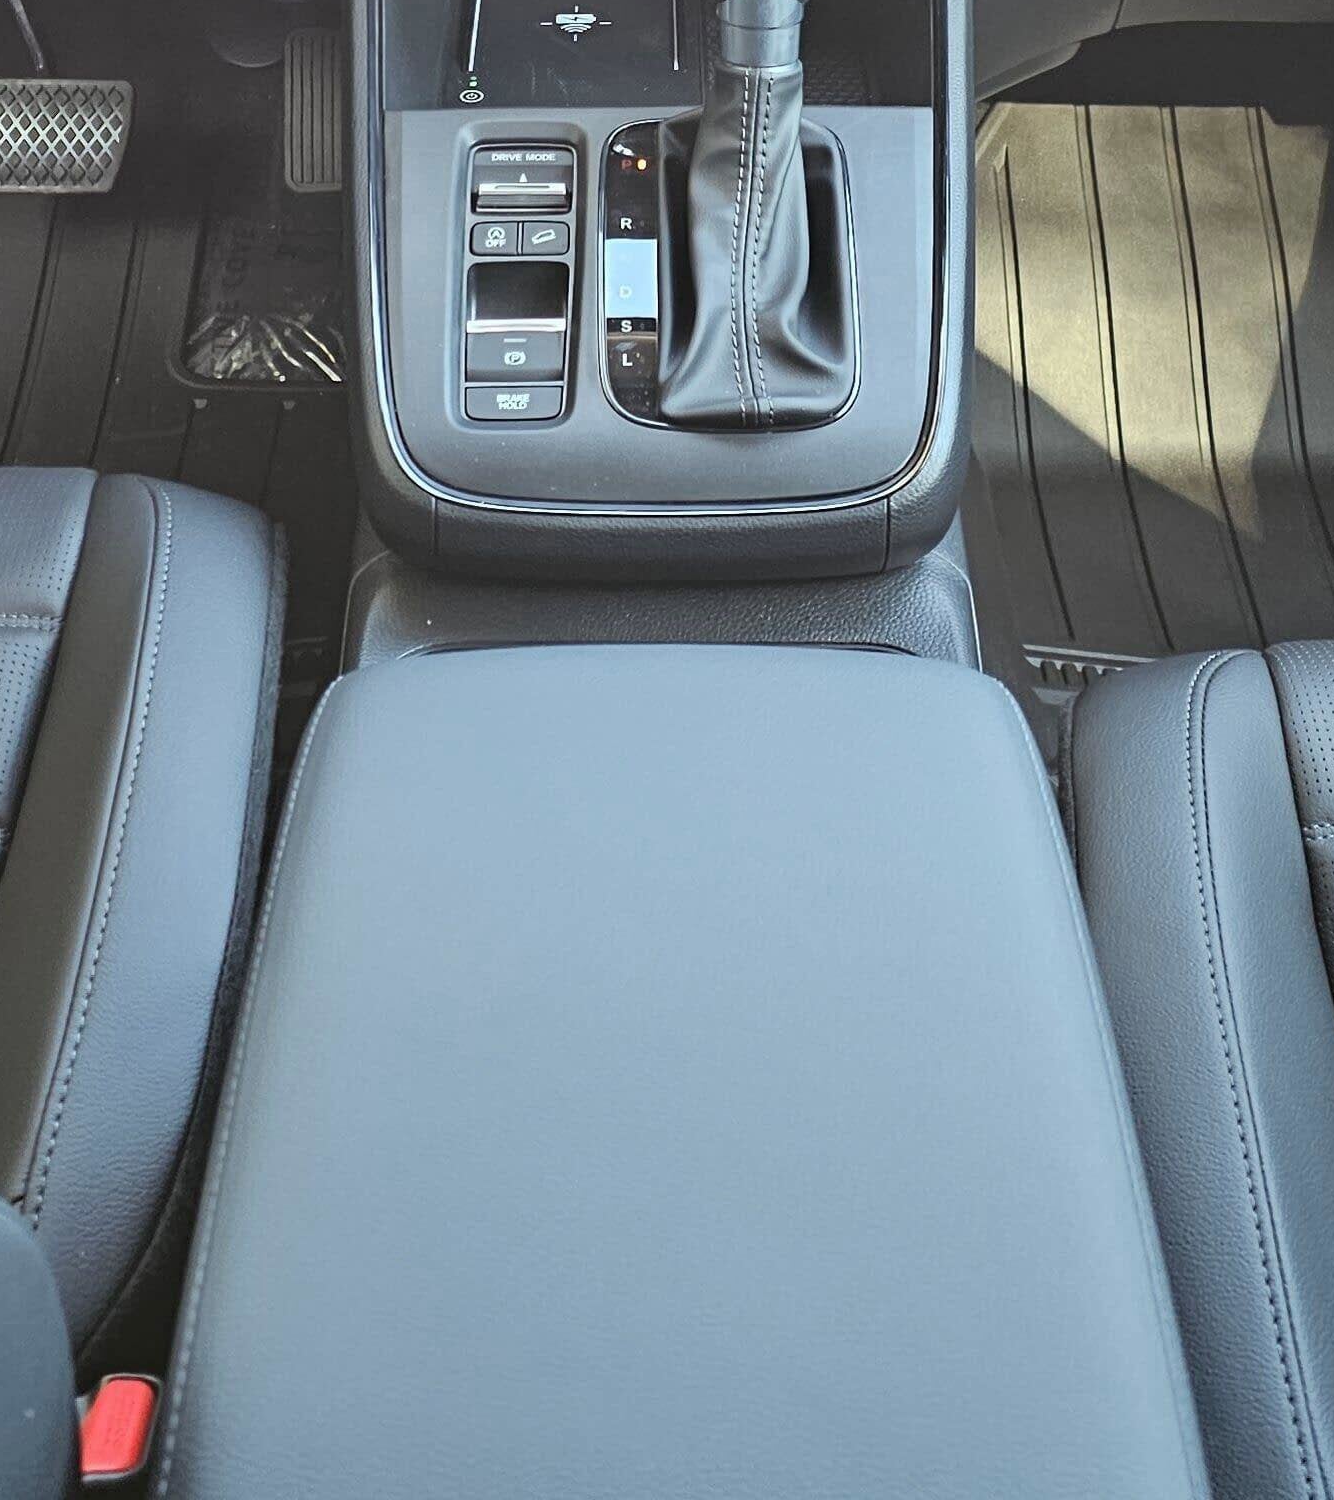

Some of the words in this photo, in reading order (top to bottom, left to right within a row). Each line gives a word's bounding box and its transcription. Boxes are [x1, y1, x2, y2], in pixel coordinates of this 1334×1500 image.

[491, 153, 523, 162] DRIVE
[525, 153, 556, 162] MODE
[621, 159, 632, 170] P
[620, 217, 633, 230] R
[485, 238, 506, 249] OFF
[619, 285, 633, 299] D
[620, 320, 633, 333] S
[621, 353, 634, 367] L
[496, 393, 530, 403] BRAKE
[498, 401, 528, 411] HOLD
